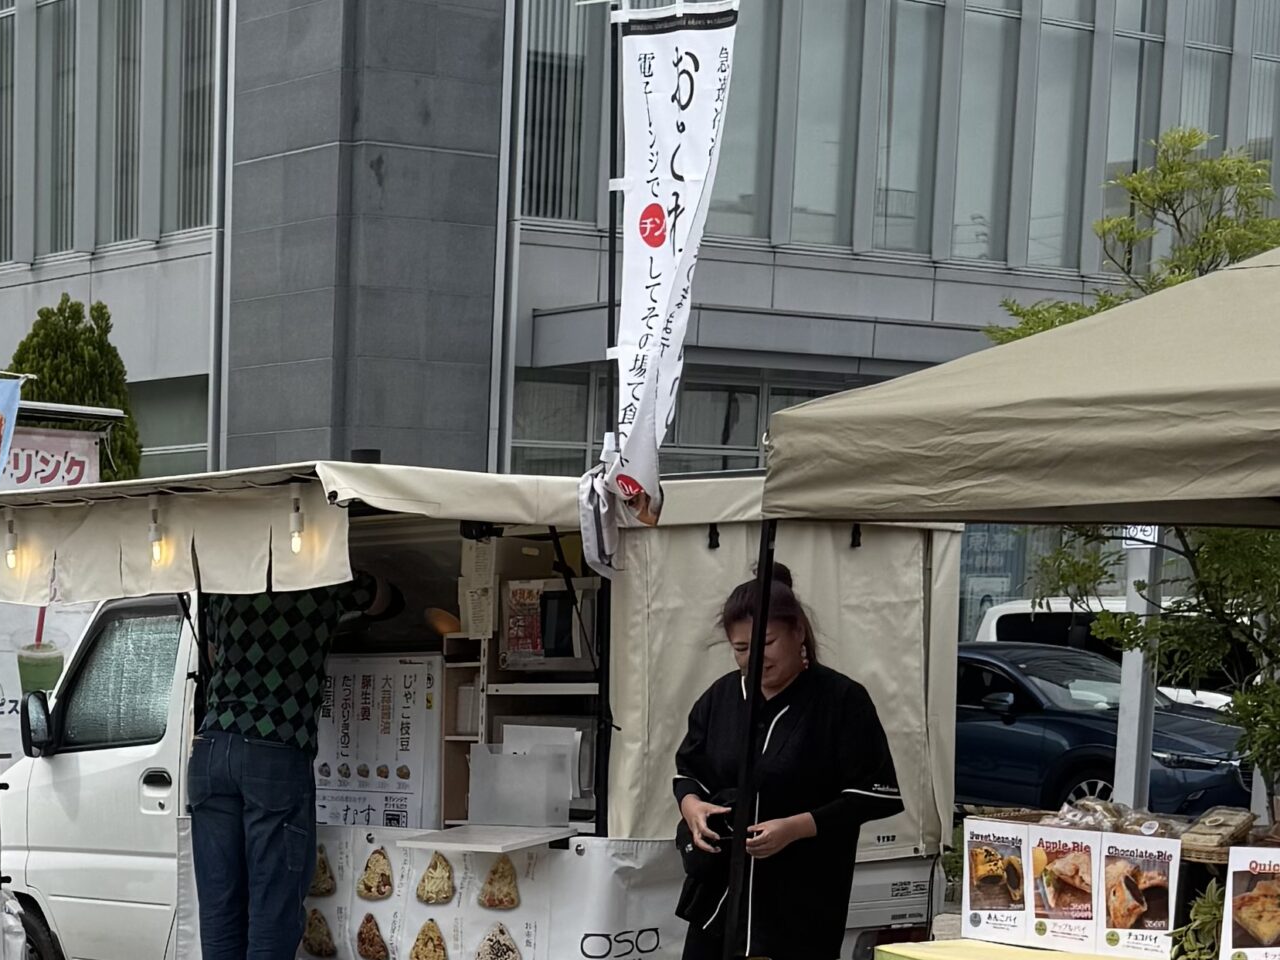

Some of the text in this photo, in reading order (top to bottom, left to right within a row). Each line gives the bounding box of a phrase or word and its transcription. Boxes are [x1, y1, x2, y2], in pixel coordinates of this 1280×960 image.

[969, 831, 1023, 847] Sweet bean pie
[1037, 837, 1092, 854] Apple Pie
[1107, 846, 1173, 862] Chocolate Pie
[580, 928, 660, 960] OSO
